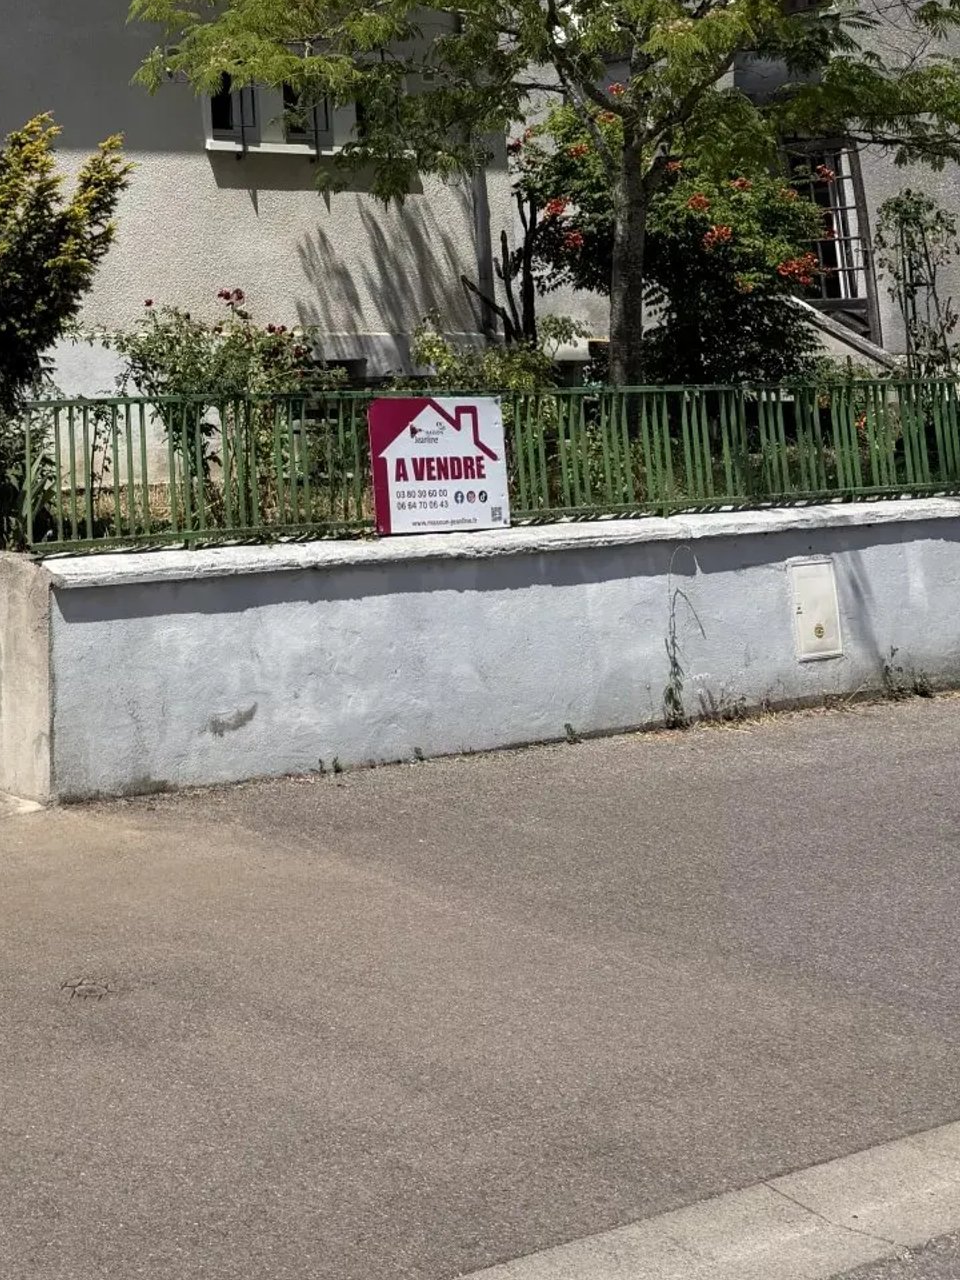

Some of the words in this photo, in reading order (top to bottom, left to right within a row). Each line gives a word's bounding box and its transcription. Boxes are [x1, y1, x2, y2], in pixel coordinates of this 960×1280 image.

[395, 457, 409, 482] A
[411, 455, 486, 481] VENDRE
[396, 490, 405, 499] 03
[407, 490, 416, 498] 80
[438, 489, 448, 497] 00
[396, 501, 406, 510] 06
[418, 501, 428, 509] 70
